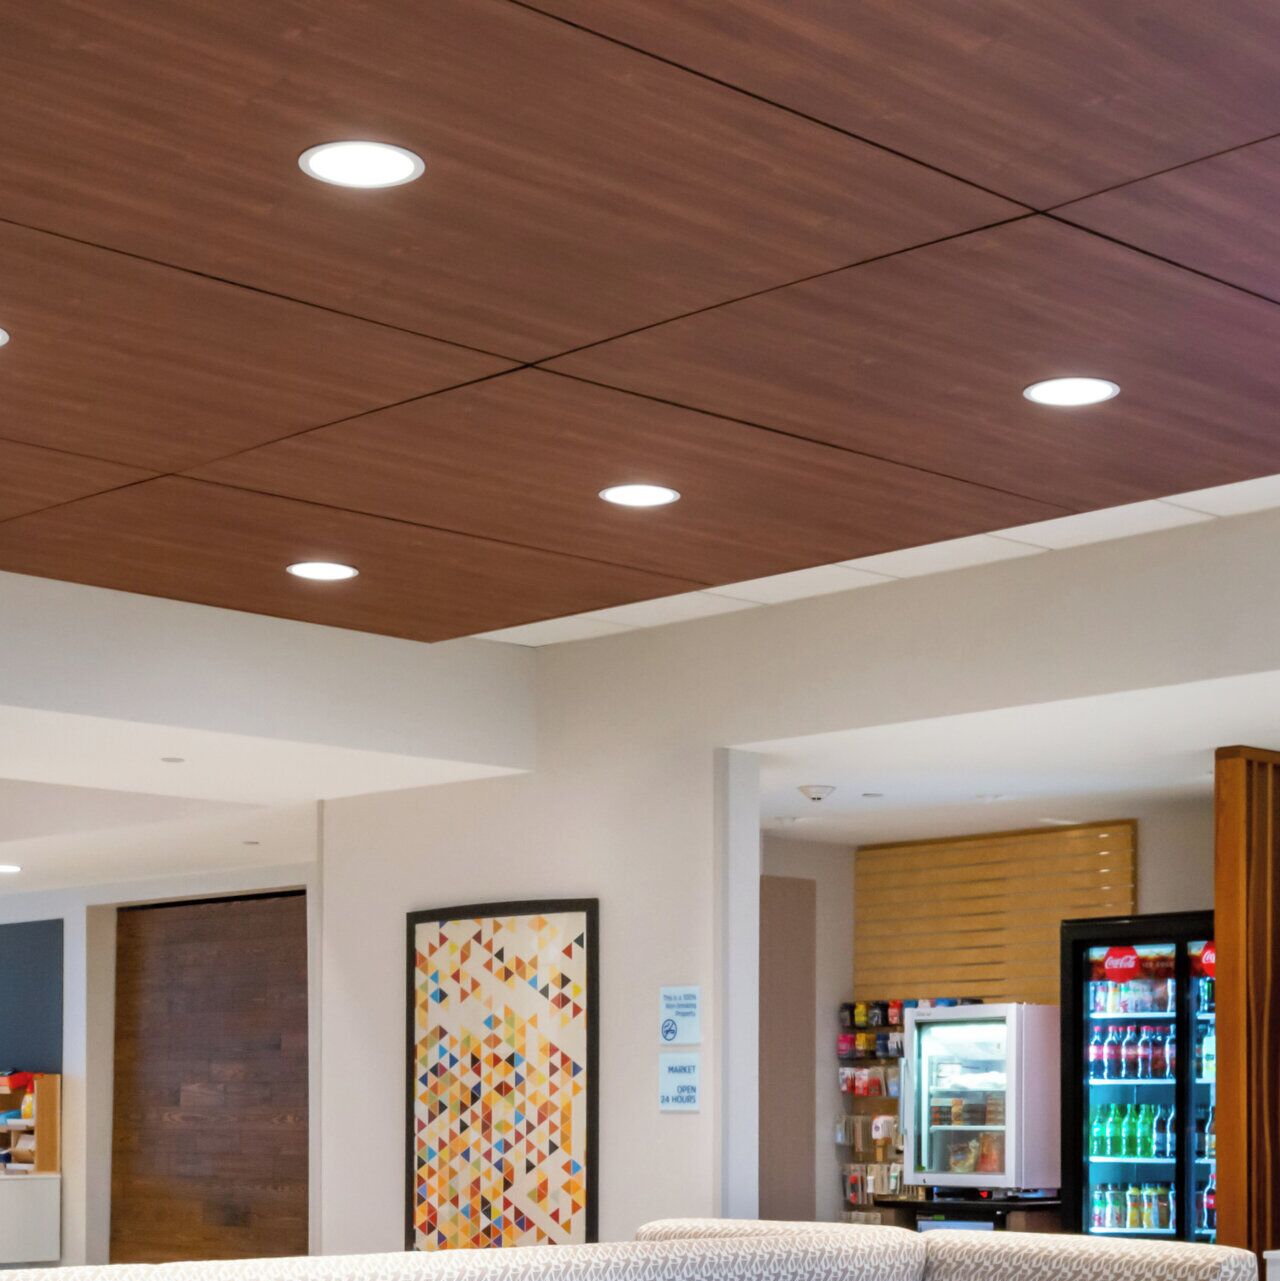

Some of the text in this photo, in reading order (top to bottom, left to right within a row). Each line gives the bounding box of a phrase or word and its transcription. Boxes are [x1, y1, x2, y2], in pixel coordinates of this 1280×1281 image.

[668, 1065, 696, 1073] MARKET
[677, 1085, 696, 1094] OPEN
[661, 1095, 696, 1104] 24 HOURS
